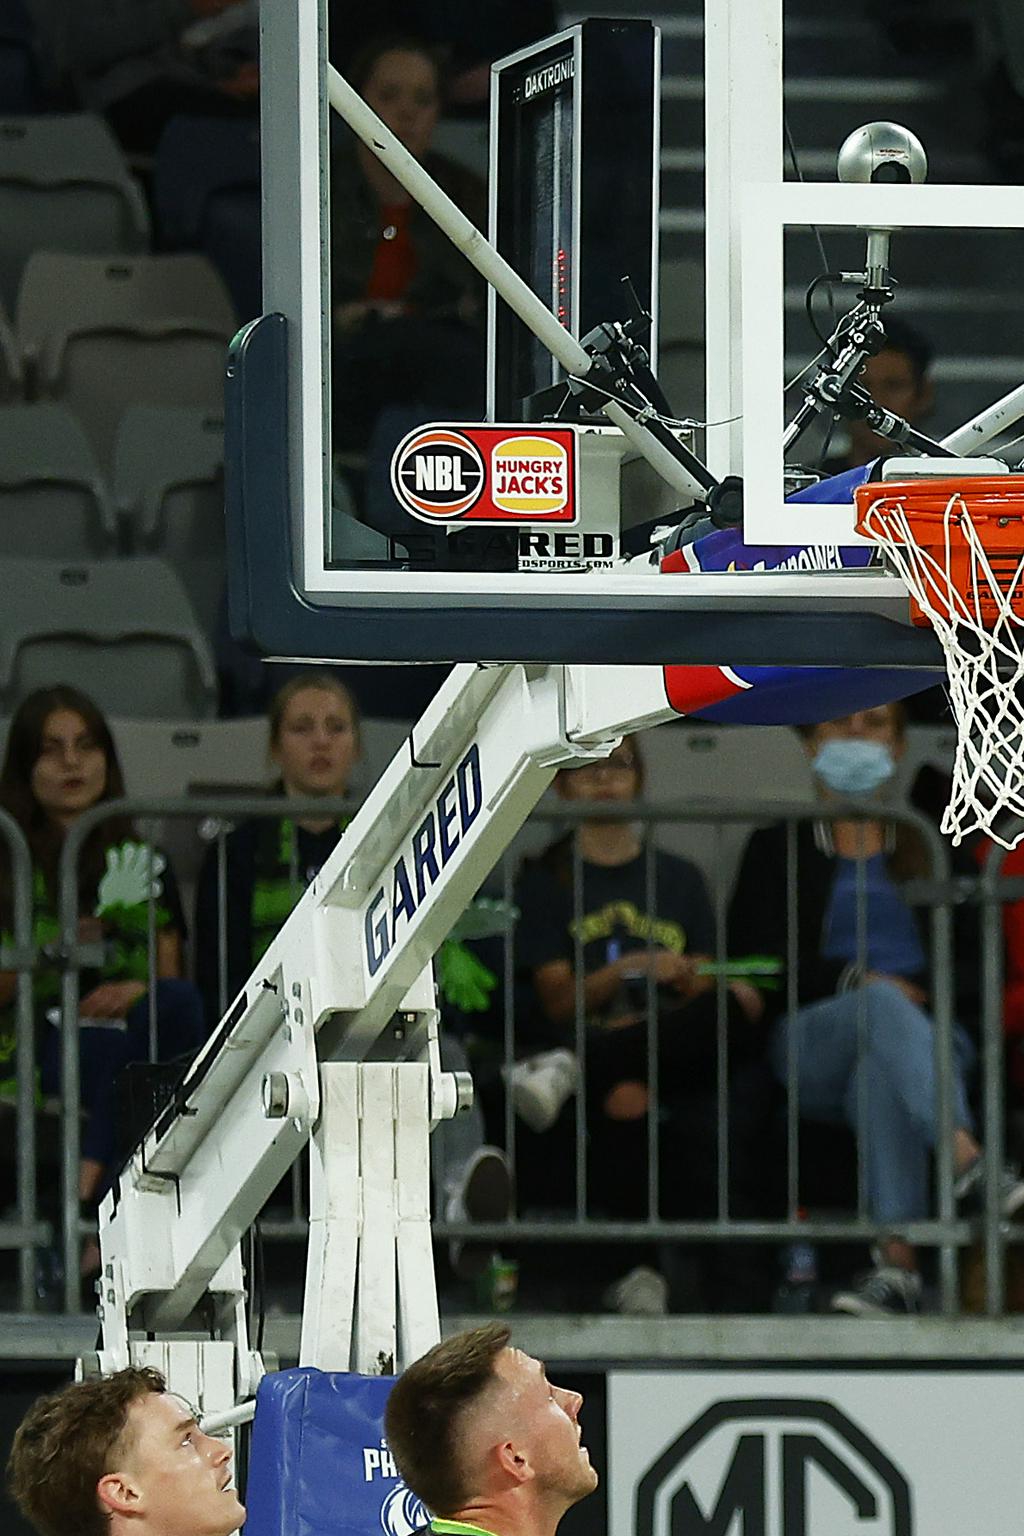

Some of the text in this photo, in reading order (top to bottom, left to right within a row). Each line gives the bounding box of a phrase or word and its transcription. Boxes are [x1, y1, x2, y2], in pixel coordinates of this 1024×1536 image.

[524, 57, 575, 98] DAKTRONIC
[414, 454, 467, 492] NBL
[496, 460, 563, 474] HUNGRY
[496, 475, 563, 495] JACK'S
[363, 743, 484, 978] GARED
